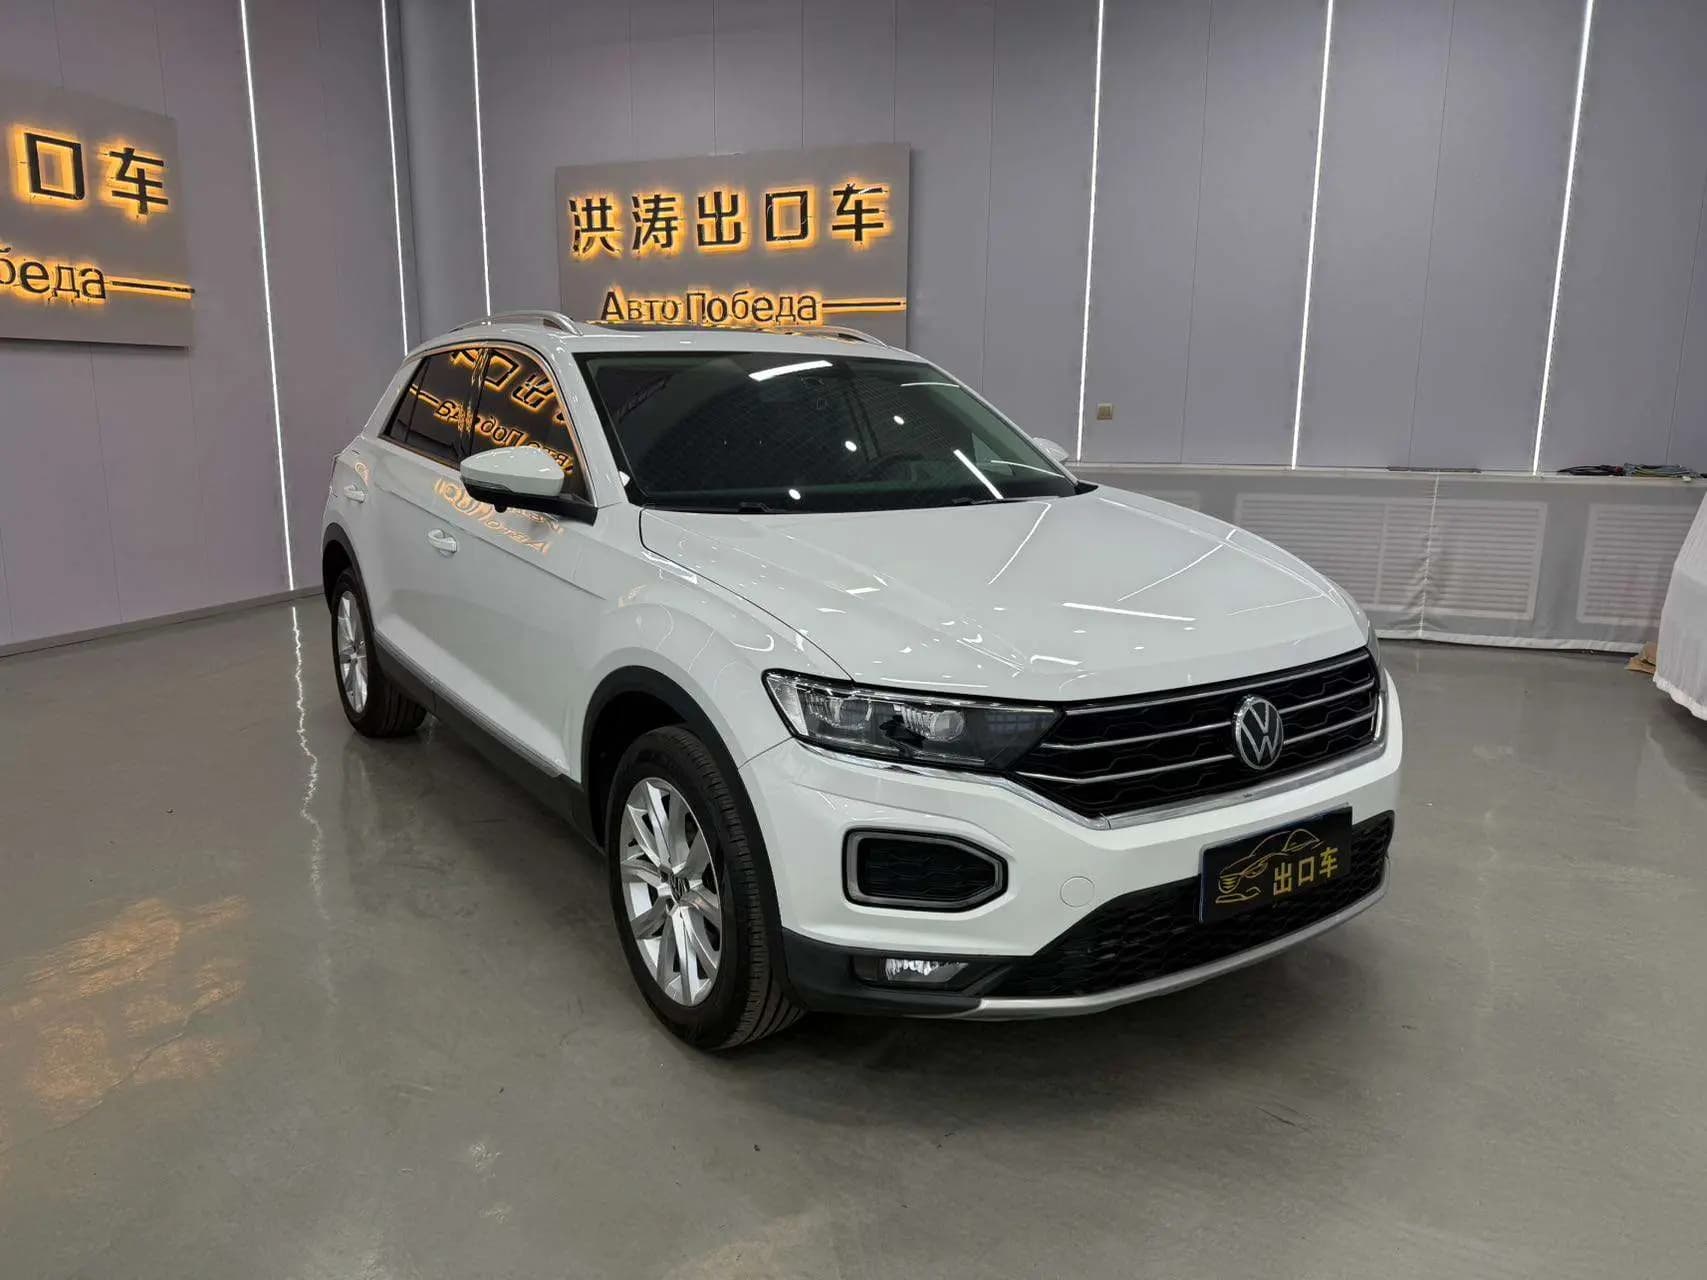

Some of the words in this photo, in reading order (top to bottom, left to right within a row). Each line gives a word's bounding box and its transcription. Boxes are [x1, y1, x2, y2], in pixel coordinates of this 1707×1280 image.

[24, 132, 169, 215] 口车
[568, 183, 885, 252] 洪涛出口车
[1237, 697, 1284, 767] VW
[1273, 846, 1338, 896] 出口车
